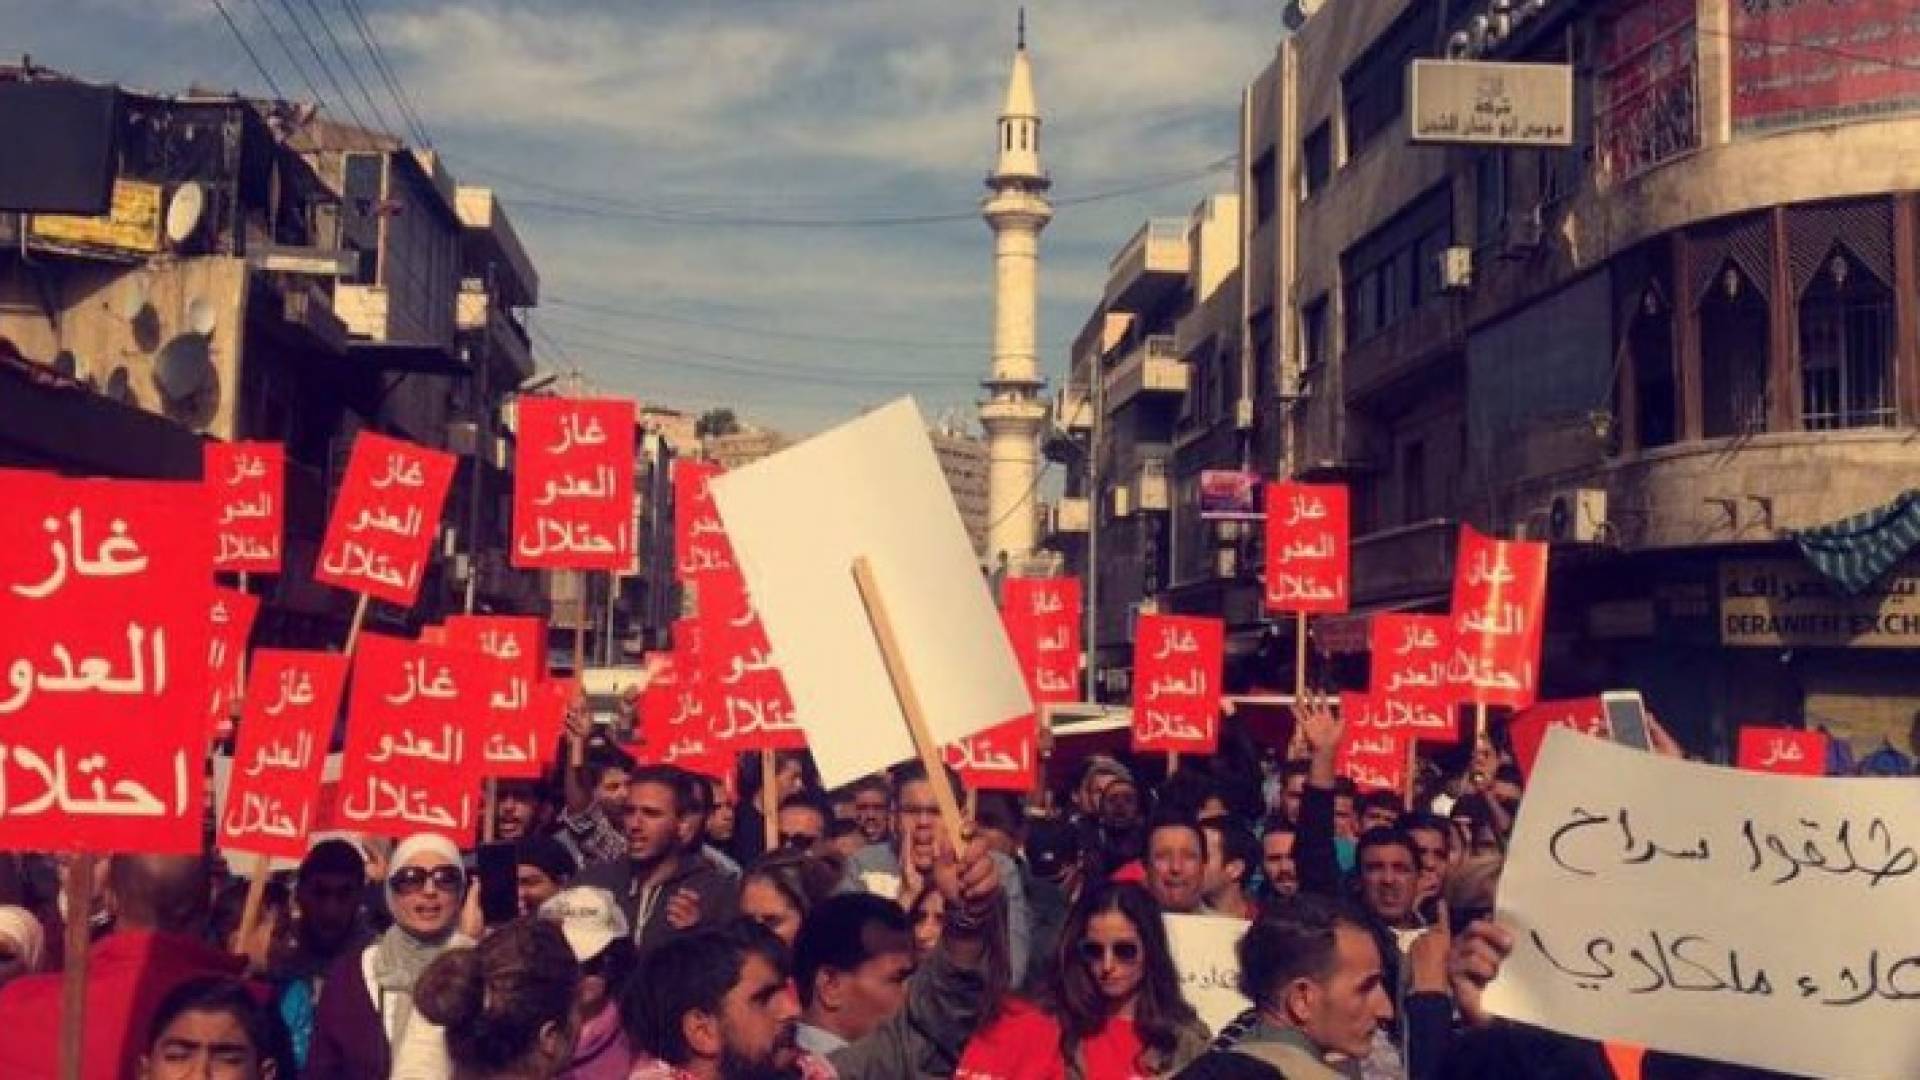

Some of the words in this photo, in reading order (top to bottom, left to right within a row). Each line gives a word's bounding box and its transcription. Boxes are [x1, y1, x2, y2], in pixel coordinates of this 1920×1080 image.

[545, 411, 607, 455] غاز
[226, 452, 267, 485] غاز
[370, 453, 425, 488] غاز
[534, 464, 616, 505] العدو
[218, 492, 271, 525] العدو
[350, 503, 424, 536] العدو
[1288, 494, 1327, 526] غاز
[10, 506, 149, 598] غاز
[212, 531, 280, 564] احتلال
[519, 516, 626, 557] احتلال
[1279, 535, 1335, 564] العدو
[322, 541, 419, 591] احتلال
[1467, 549, 1516, 588] غاز
[1268, 573, 1343, 601] احتلال
[1153, 625, 1198, 659] غاز
[1395, 622, 1440, 655] غاز
[0, 621, 167, 714] العدو
[386, 657, 459, 704] غاز
[1146, 668, 1206, 700] العدو
[1386, 662, 1445, 692] العدو
[264, 667, 314, 715] غاز
[1138, 709, 1214, 741] احتلال
[1372, 697, 1454, 729] احتلال
[244, 730, 313, 776] العدو
[366, 722, 465, 766] العدو
[941, 736, 1030, 772] احتلا
[1345, 733, 1395, 757] العدو
[1761, 736, 1804, 764] غاز
[224, 791, 310, 839] احتلال
[343, 775, 471, 830] احتلال
